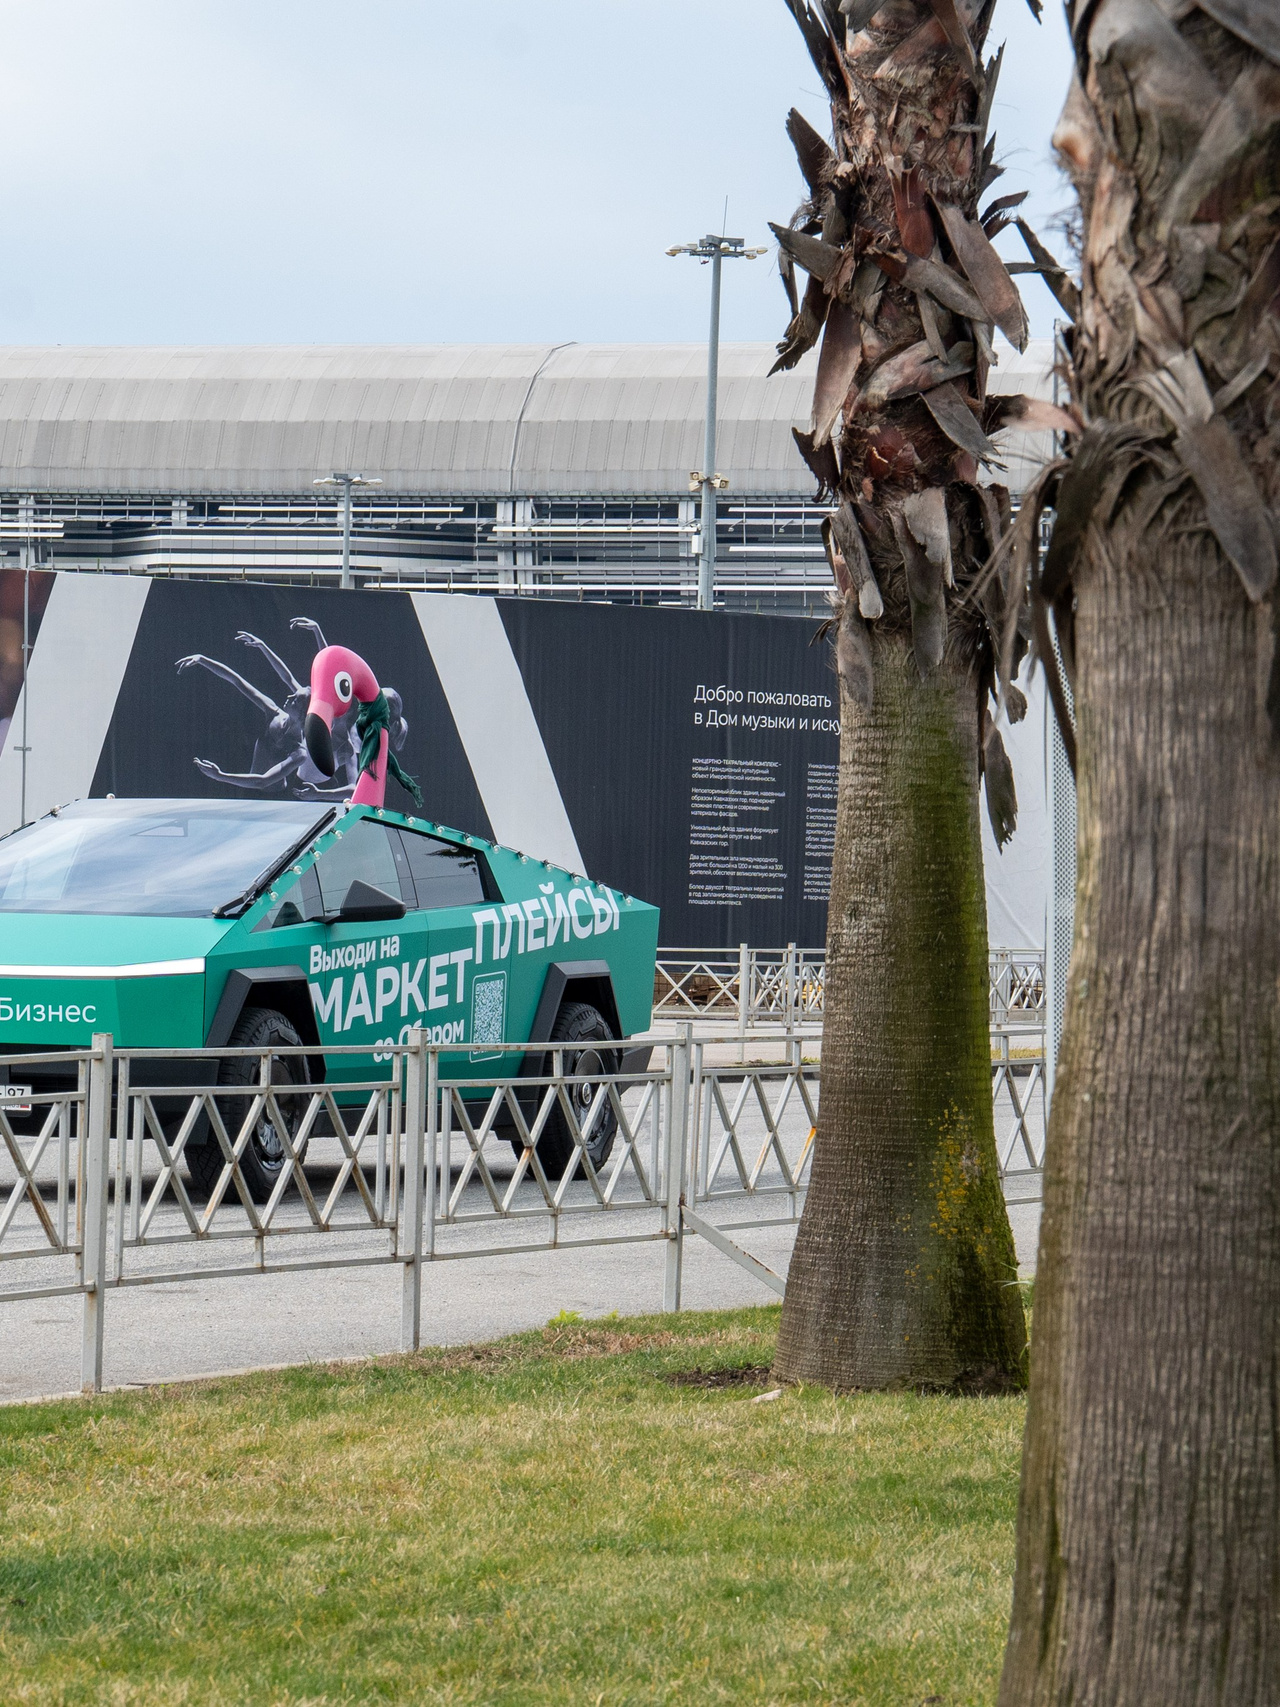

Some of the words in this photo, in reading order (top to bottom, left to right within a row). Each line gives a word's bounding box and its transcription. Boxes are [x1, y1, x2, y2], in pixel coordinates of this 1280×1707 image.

[694, 685, 743, 705] Добро
[747, 691, 832, 707] пожаловать
[694, 712, 702, 724] в
[706, 709, 738, 728] Дом
[742, 714, 795, 731] музыки
[799, 718, 808, 730] и
[472, 882, 619, 964] ПЛЕЙСЫ
[310, 940, 376, 974] Выходи
[381, 935, 400, 959] на
[309, 948, 473, 1033] МАРКЕТ
[398, 1019, 465, 1055] Сером
